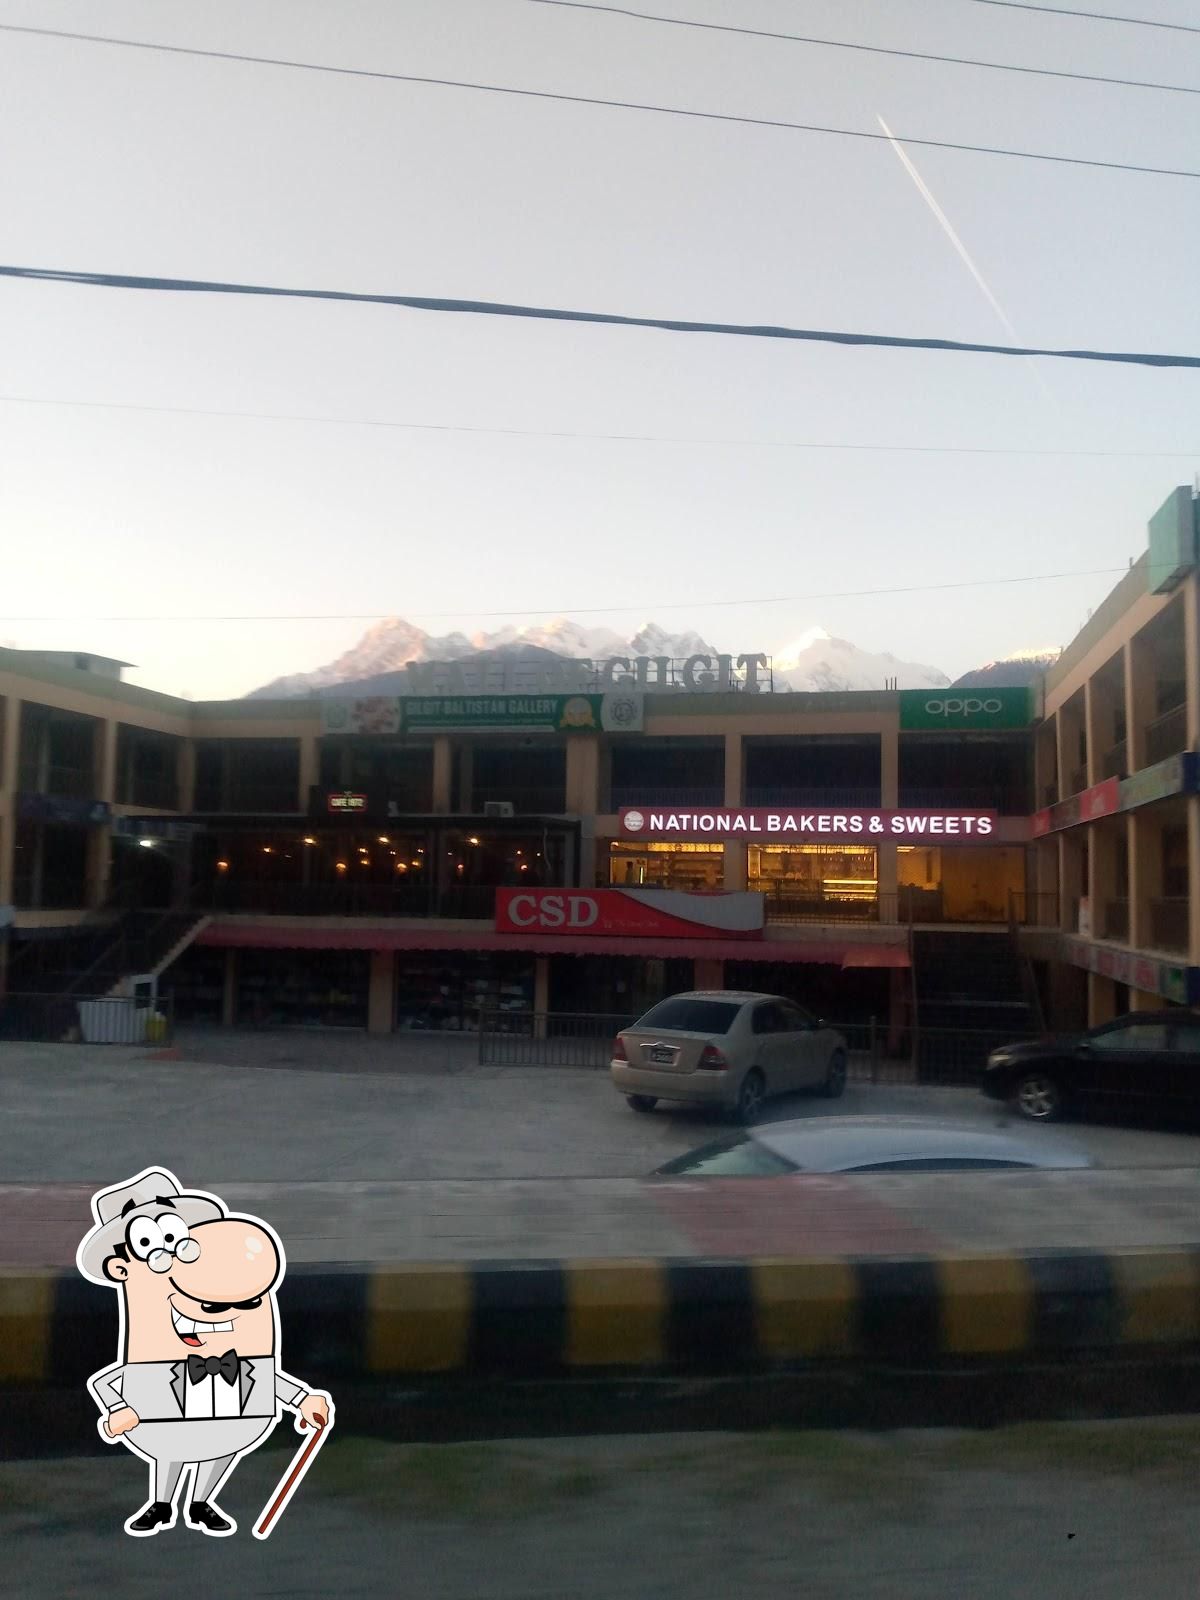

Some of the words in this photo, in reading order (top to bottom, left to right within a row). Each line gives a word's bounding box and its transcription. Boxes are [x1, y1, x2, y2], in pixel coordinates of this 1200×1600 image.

[508, 699, 558, 714] GALLERY
[650, 814, 762, 832] NATIONAL
[767, 815, 863, 833] BAKERS
[869, 815, 884, 833] &
[890, 816, 992, 835] SWEETS
[507, 895, 599, 928] CSD
